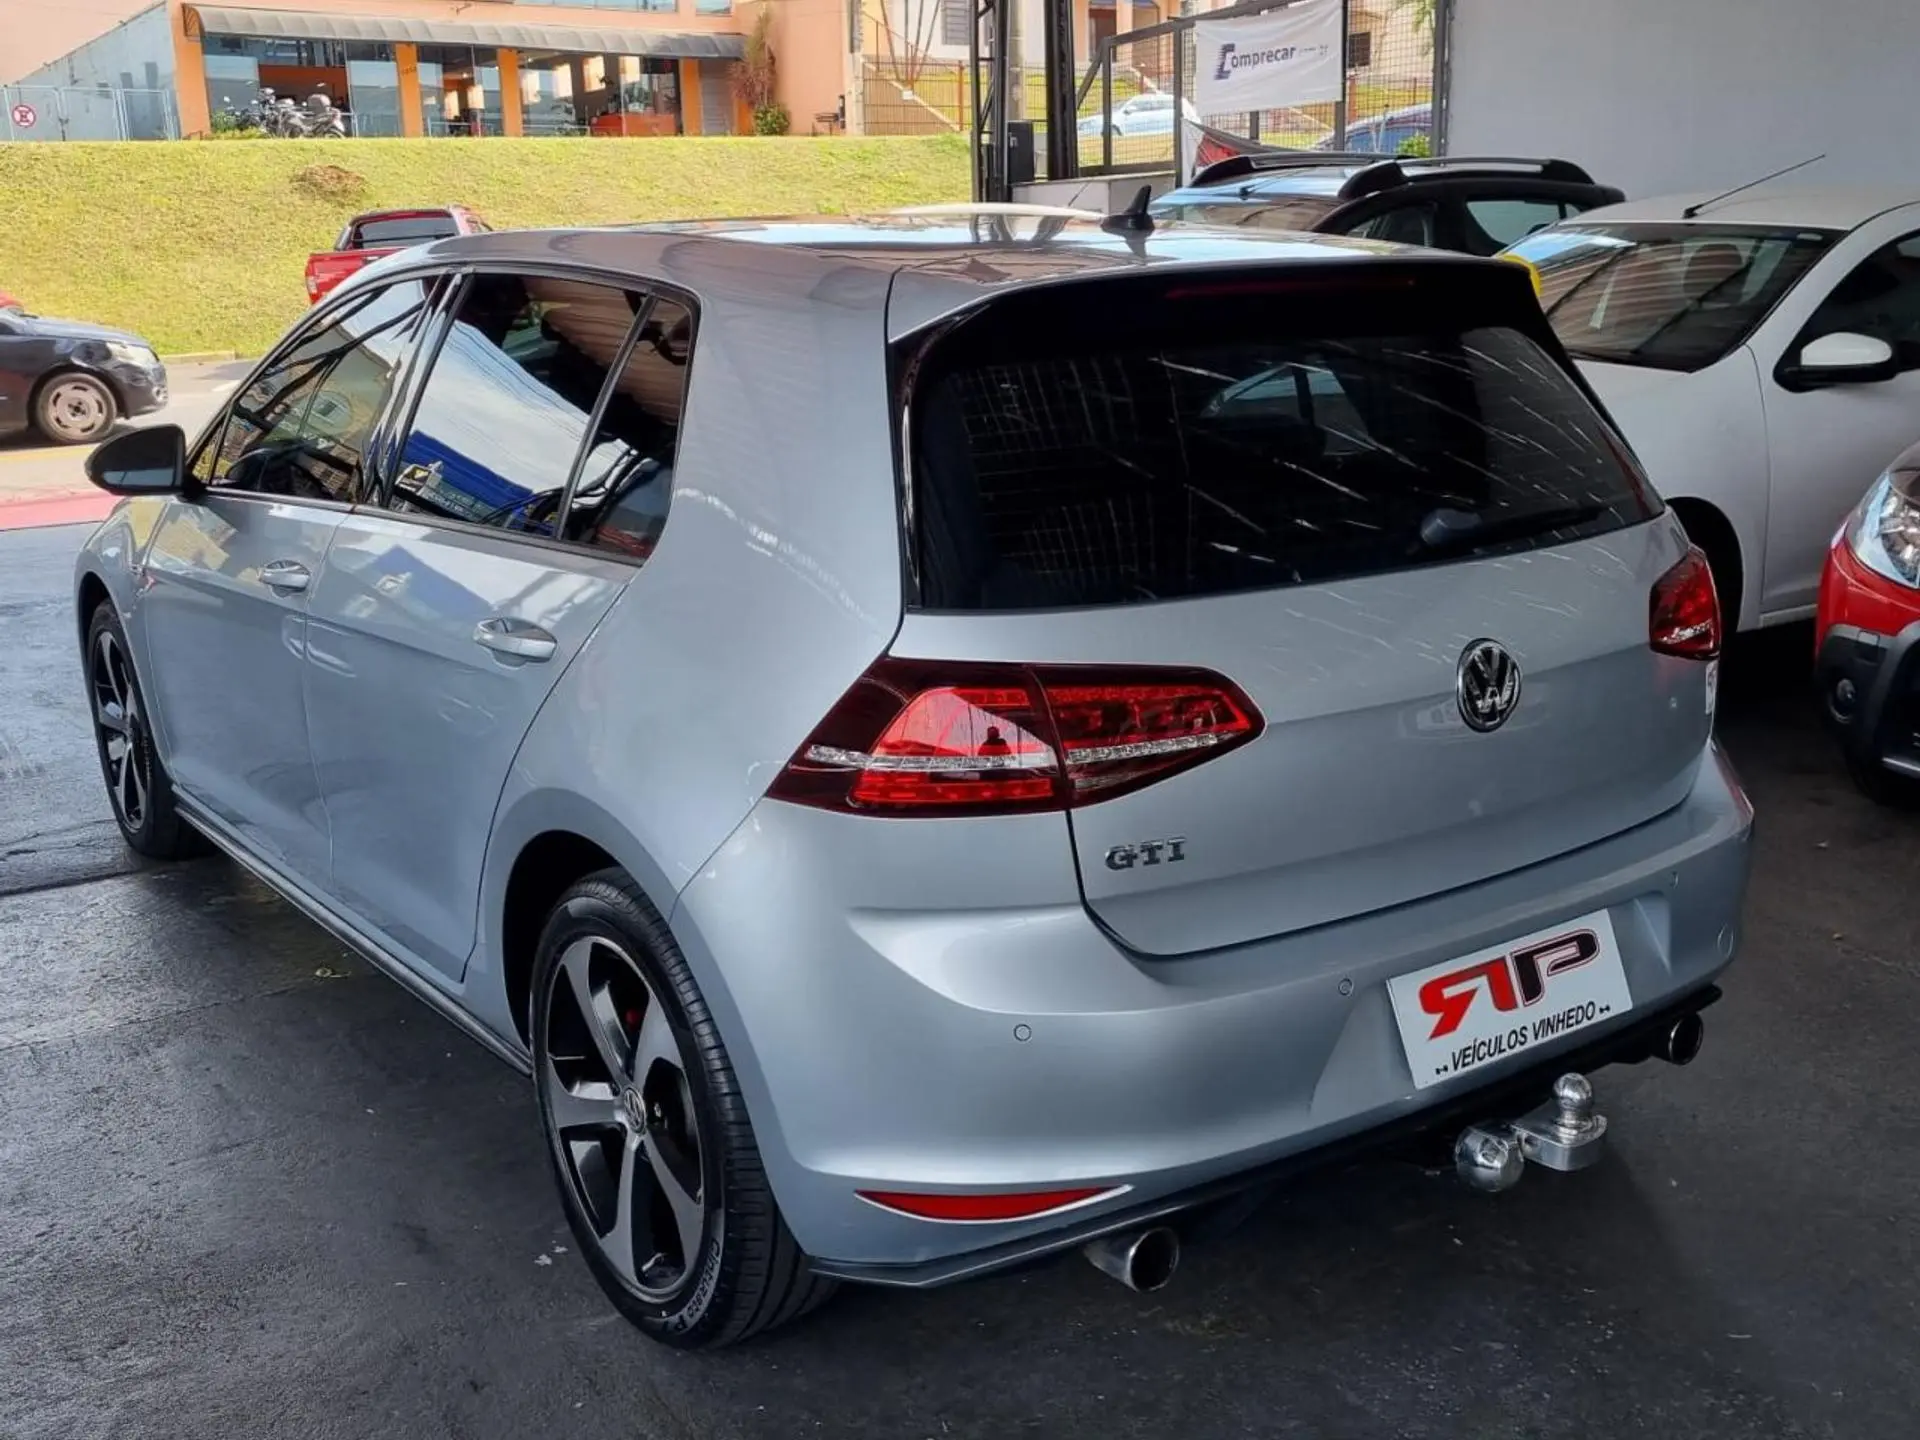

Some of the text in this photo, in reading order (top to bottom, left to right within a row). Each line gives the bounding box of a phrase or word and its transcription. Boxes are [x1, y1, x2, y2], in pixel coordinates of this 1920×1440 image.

[1214, 43, 1296, 80] Comprecar
[1105, 837, 1186, 871] GTI
[1451, 1001, 1595, 1071] VEÍCULOS VINHEDO
